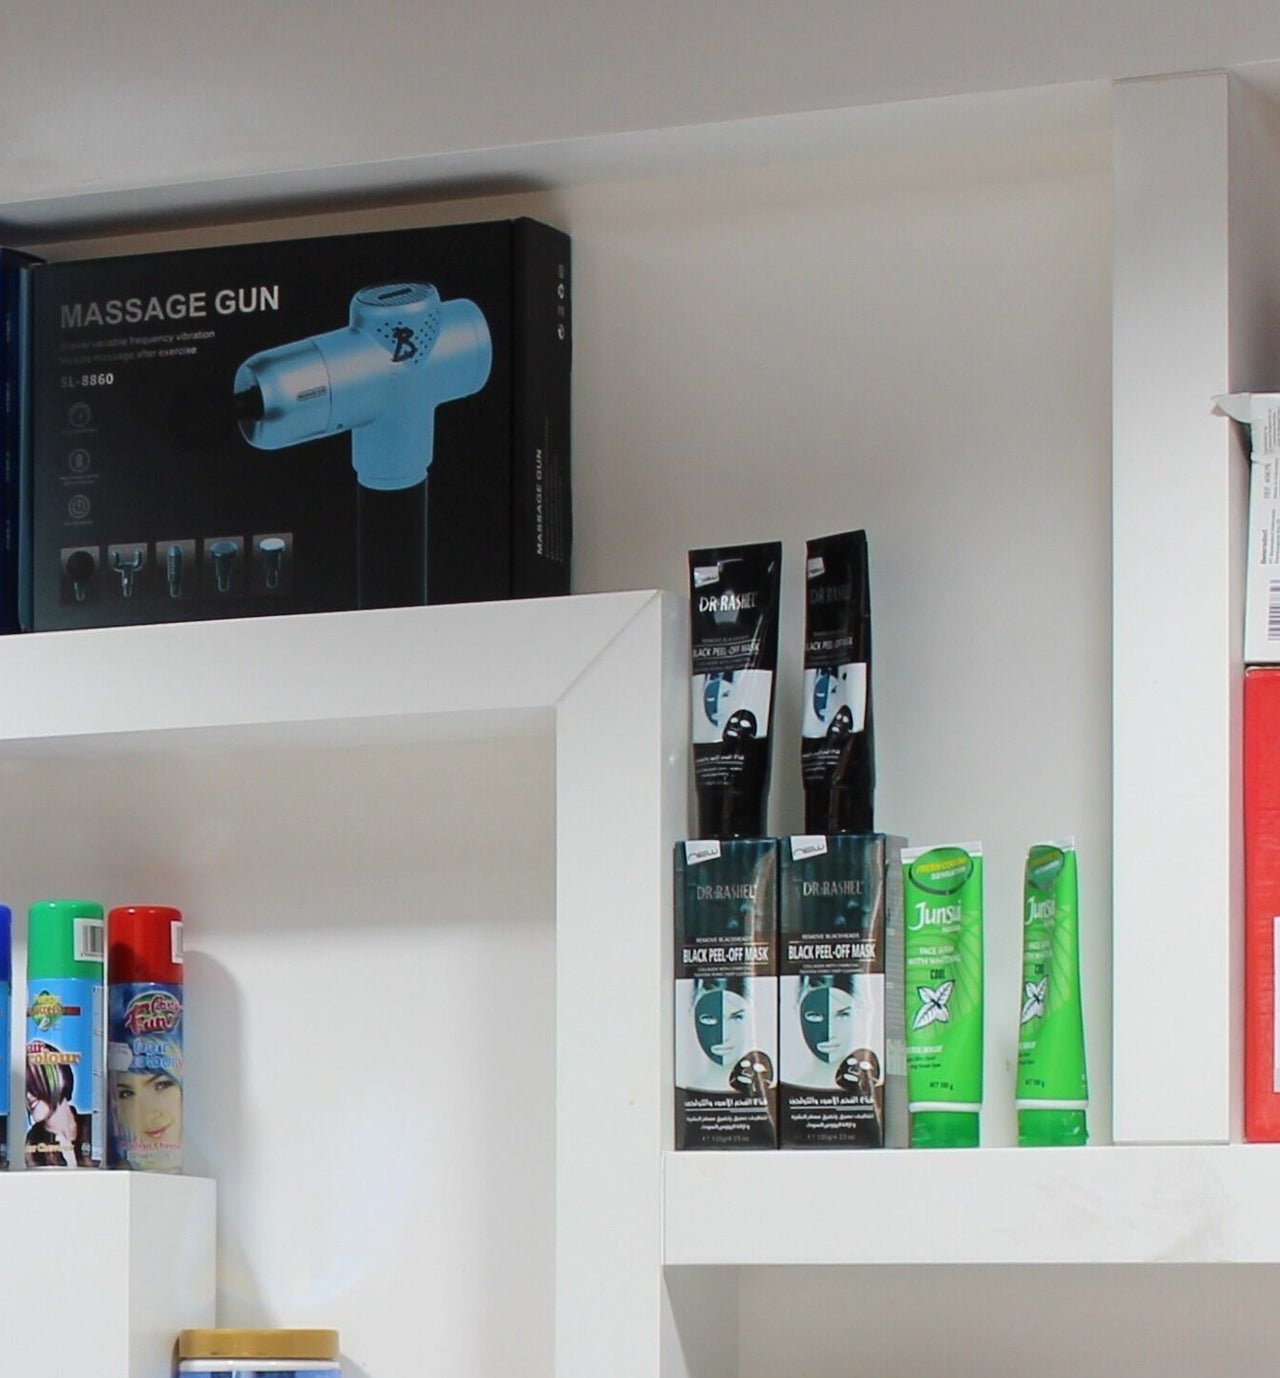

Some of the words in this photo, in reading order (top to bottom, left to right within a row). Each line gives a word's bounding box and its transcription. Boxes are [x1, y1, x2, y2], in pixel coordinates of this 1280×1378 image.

[60, 292, 207, 329] MASSAGE
[215, 285, 279, 315] GUN
[176, 330, 216, 341] vibration
[158, 346, 198, 357] exercise
[60, 373, 115, 389] SL-8860
[682, 948, 708, 963] BLACK
[708, 946, 744, 963] PEEL-OFF
[744, 946, 770, 961] MASK
[788, 945, 814, 960] BLACK
[815, 943, 851, 959] PEEL-OFF
[851, 943, 876, 959] MASK
